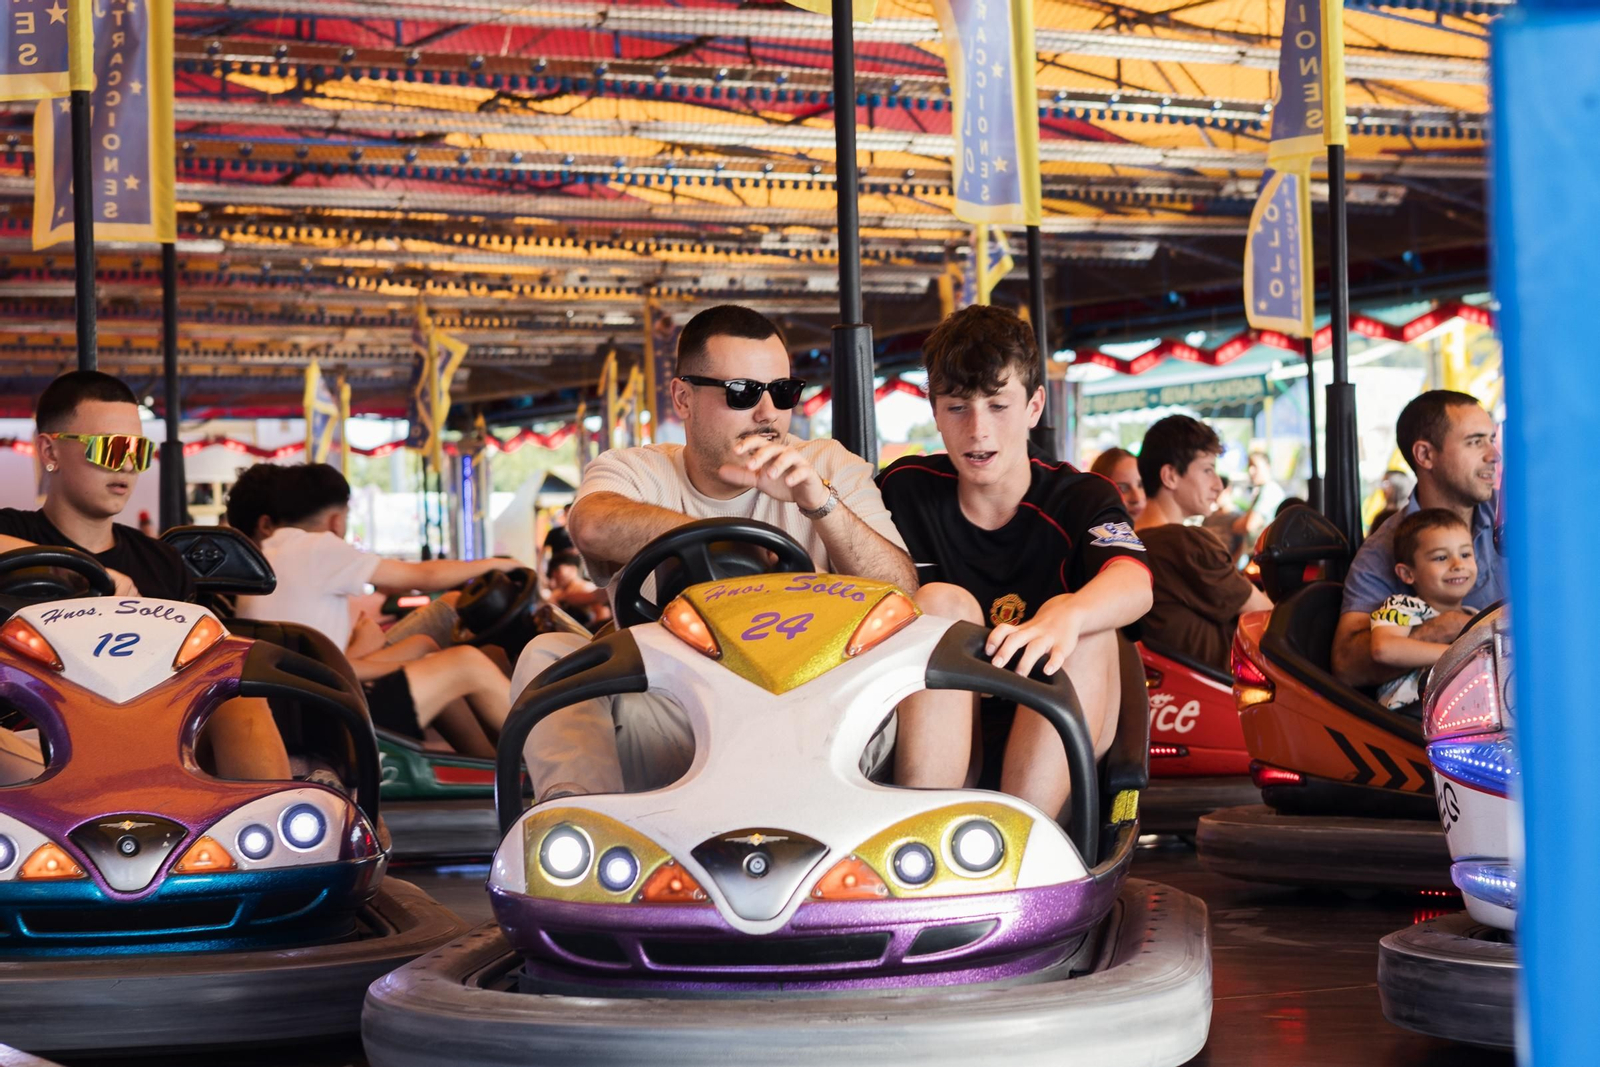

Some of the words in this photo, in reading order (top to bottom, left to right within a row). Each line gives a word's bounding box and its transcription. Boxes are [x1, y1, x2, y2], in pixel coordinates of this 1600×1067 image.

[704, 582, 771, 602] Hnos.
[785, 575, 866, 601] Sollo
[40, 605, 103, 625] Hnos.
[114, 600, 188, 624] Sollo
[740, 611, 814, 640] 24
[92, 632, 141, 657] 12
